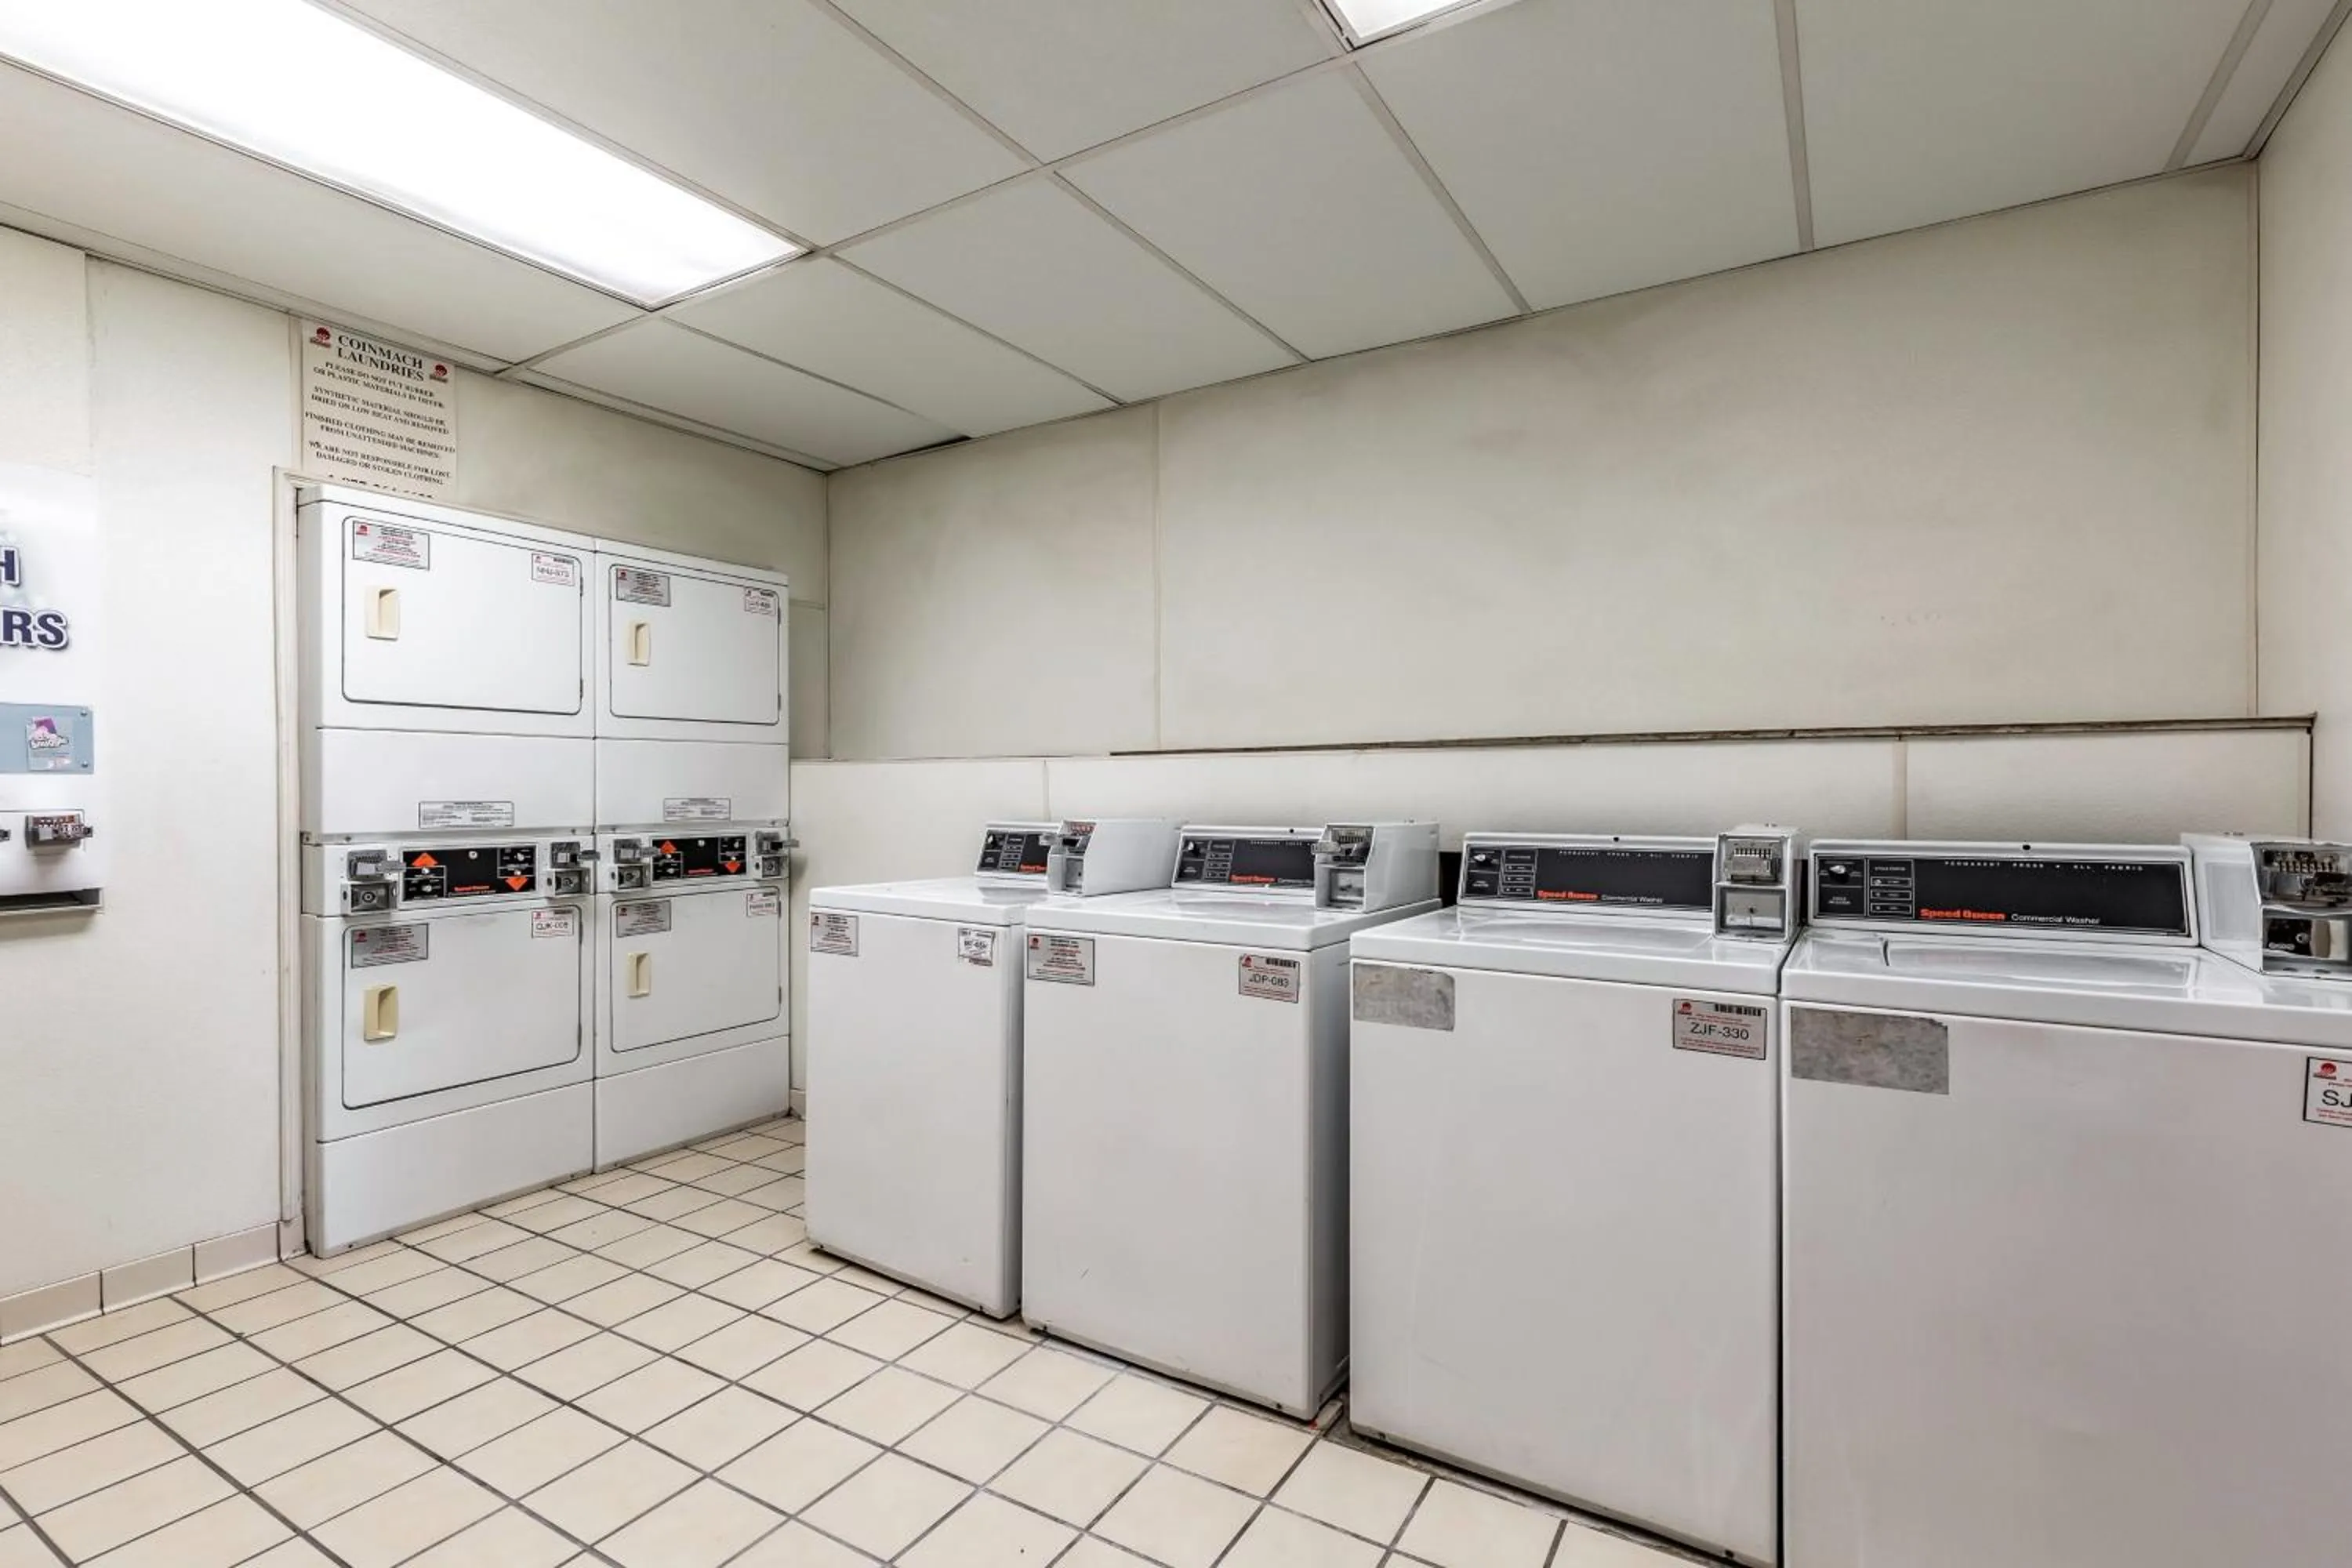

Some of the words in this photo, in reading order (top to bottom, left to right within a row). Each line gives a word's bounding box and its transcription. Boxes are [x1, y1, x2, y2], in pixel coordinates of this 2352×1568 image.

[338, 335, 423, 369] COINMACH
[338, 347, 424, 381] LAUNDRIES
[313, 366, 325, 376] OR
[327, 371, 361, 385] PLASTIC
[363, 380, 406, 398] MATERIALS
[325, 361, 354, 374] PLEASE
[371, 375, 387, 383] NOT
[388, 379, 402, 389] PUT
[311, 394, 336, 406] DRIED
[352, 405, 369, 414] LOW
[372, 410, 393, 421] HEAT
[394, 416, 410, 425] AND
[411, 421, 449, 434] REMOVED
[314, 386, 360, 404] SYNTHETIC
[403, 410, 434, 422] SHOULD
[305, 411, 343, 427] FINISHED
[344, 423, 387, 437] CLOTHING
[387, 433, 404, 441] MAY
[417, 440, 456, 452] REMOVED
[320, 424, 340, 434] FROM
[341, 430, 398, 448] UNATTENDED
[316, 451, 358, 466] DAMAGED
[372, 465, 402, 476] STOLEN
[361, 454, 411, 470] RESPONSIBLE
[413, 463, 429, 473] FOR
[1537, 891, 1566, 899] Speed
[1568, 891, 1598, 900] Queen
[1920, 909, 1960, 919] Speed
[1962, 910, 2005, 920] Queen
[2011, 913, 2063, 923] Commercial
[2065, 916, 2100, 924] Washer
[1690, 1022, 1749, 1040] ZJF-330
